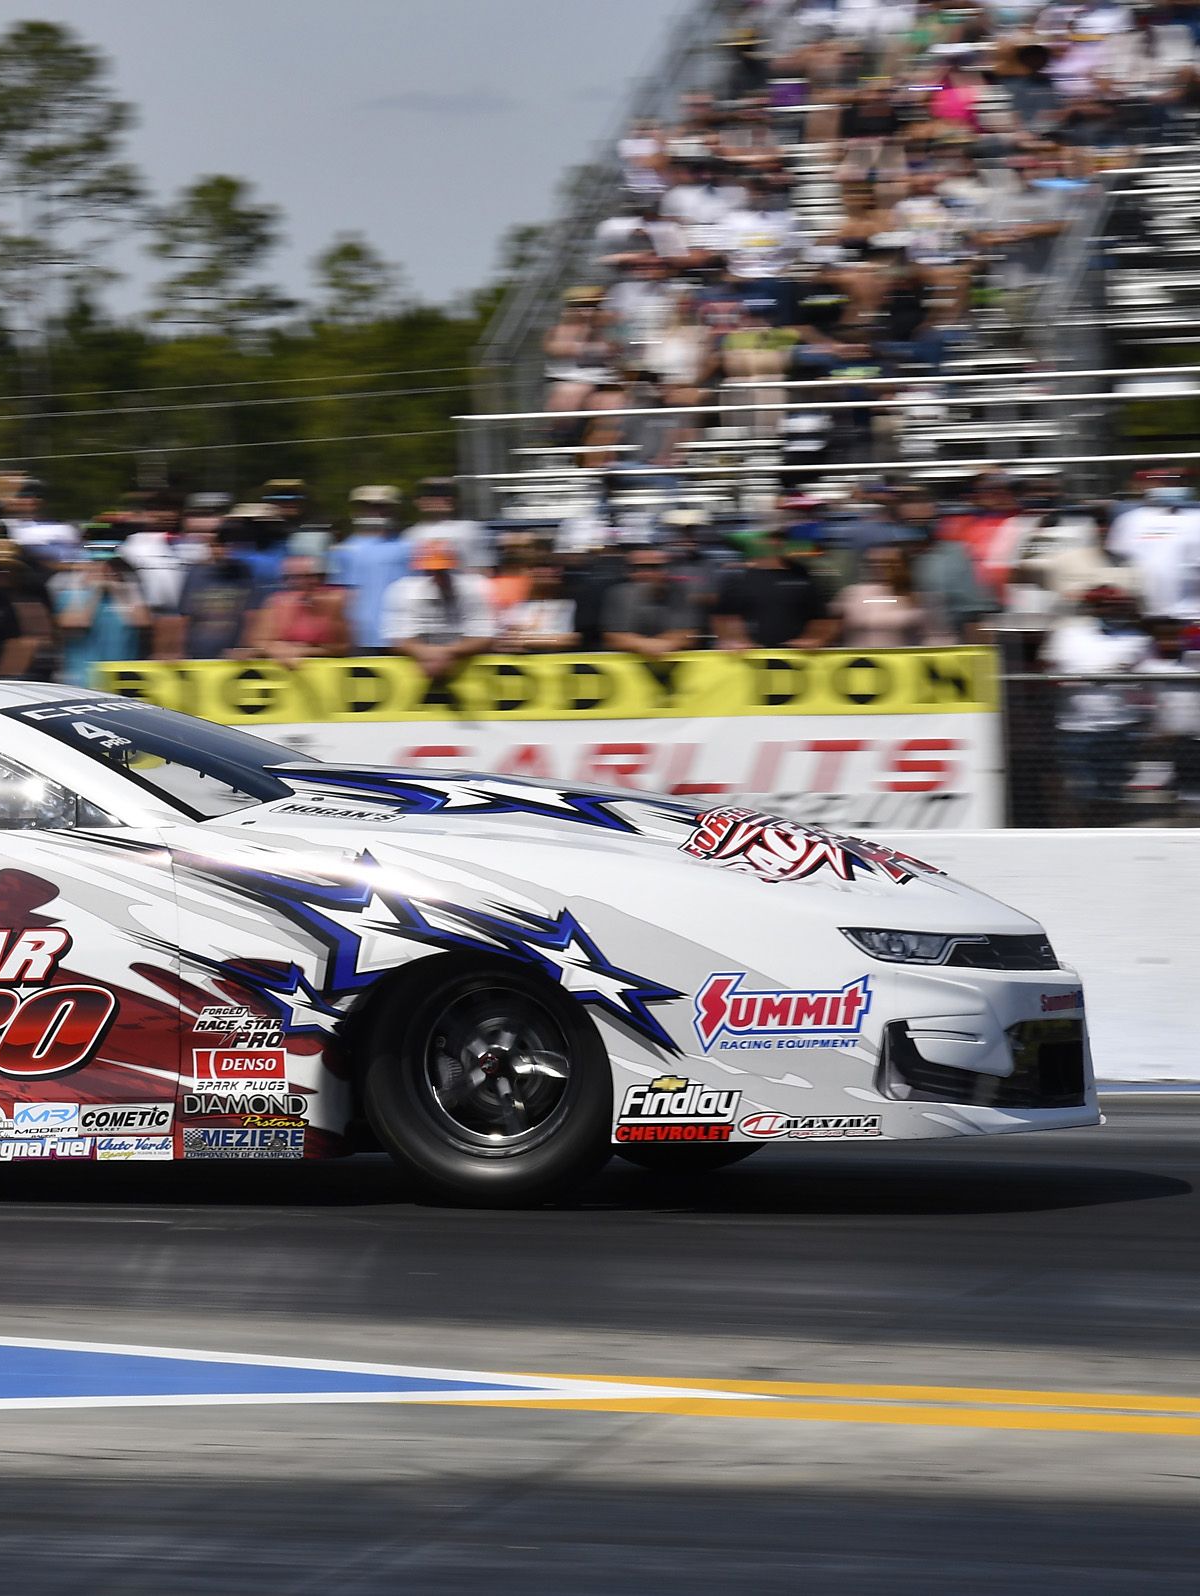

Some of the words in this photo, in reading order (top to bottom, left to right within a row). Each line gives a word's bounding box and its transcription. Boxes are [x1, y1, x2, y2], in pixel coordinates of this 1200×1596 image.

[108, 668, 284, 715] BIG
[338, 660, 690, 714] DADDY
[750, 656, 968, 707] DON
[72, 721, 119, 740] 4
[100, 737, 132, 749] PRO
[281, 804, 397, 821] HOGAN'S
[202, 1007, 245, 1016] FORGED
[195, 1020, 237, 1031] RACE
[243, 1020, 282, 1030] STAR
[231, 1031, 284, 1048] PRO
[720, 1040, 772, 1050] RACING
[777, 1039, 859, 1049] EQUIPMENT
[221, 1058, 277, 1071] DENSO
[196, 1081, 238, 1091] SPARK
[244, 1081, 286, 1091] PLUGS
[184, 1094, 308, 1115] DIAMOND
[618, 1084, 742, 1124] Findlay
[18, 1109, 71, 1124] MR
[81, 1110, 170, 1127] COMETIC
[241, 1115, 308, 1127] Pistons
[780, 1116, 878, 1129] MAXIMA
[202, 1129, 304, 1147] MEZIERE
[616, 1125, 734, 1141] CHEVROLET
[98, 1138, 133, 1151] Auto
[135, 1138, 172, 1151] Verdi
